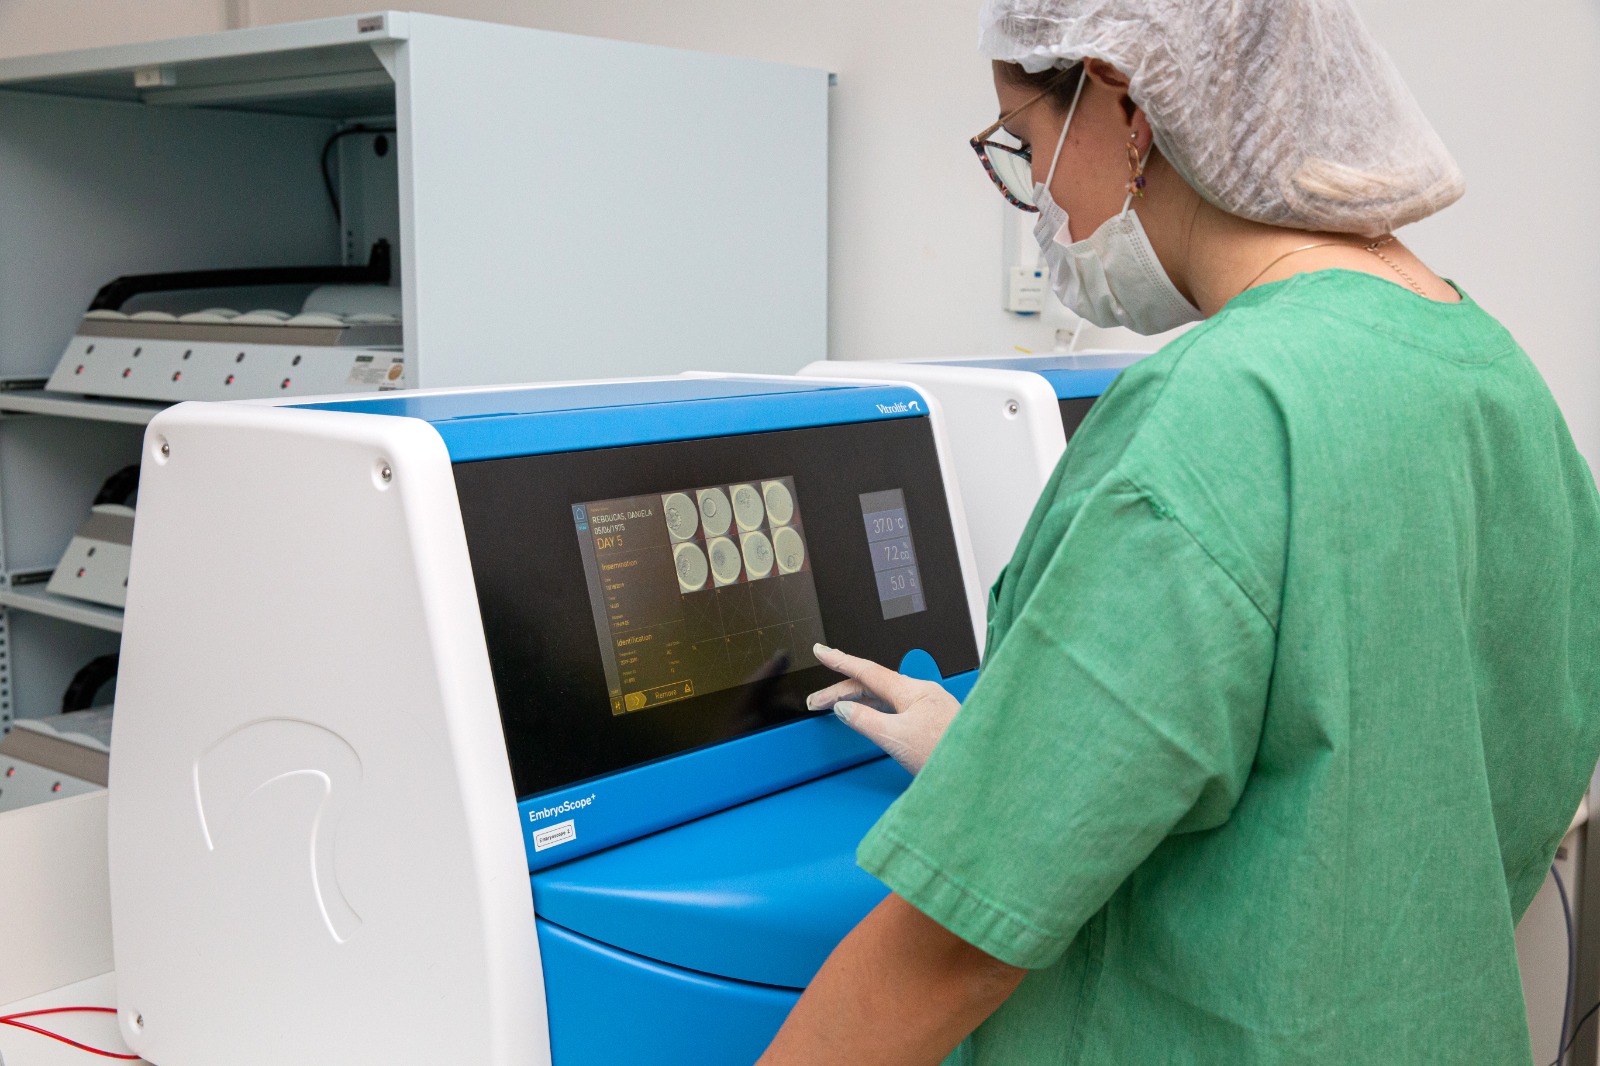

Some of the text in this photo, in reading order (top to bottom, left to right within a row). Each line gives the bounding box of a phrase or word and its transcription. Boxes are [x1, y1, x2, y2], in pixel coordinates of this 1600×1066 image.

[876, 402, 908, 414] Vitrolife
[873, 517, 893, 533] 37.0
[597, 535, 623, 550] DAY 5
[601, 560, 638, 571] Insemination
[890, 575, 905, 591] 5.0
[616, 634, 653, 647] Identification
